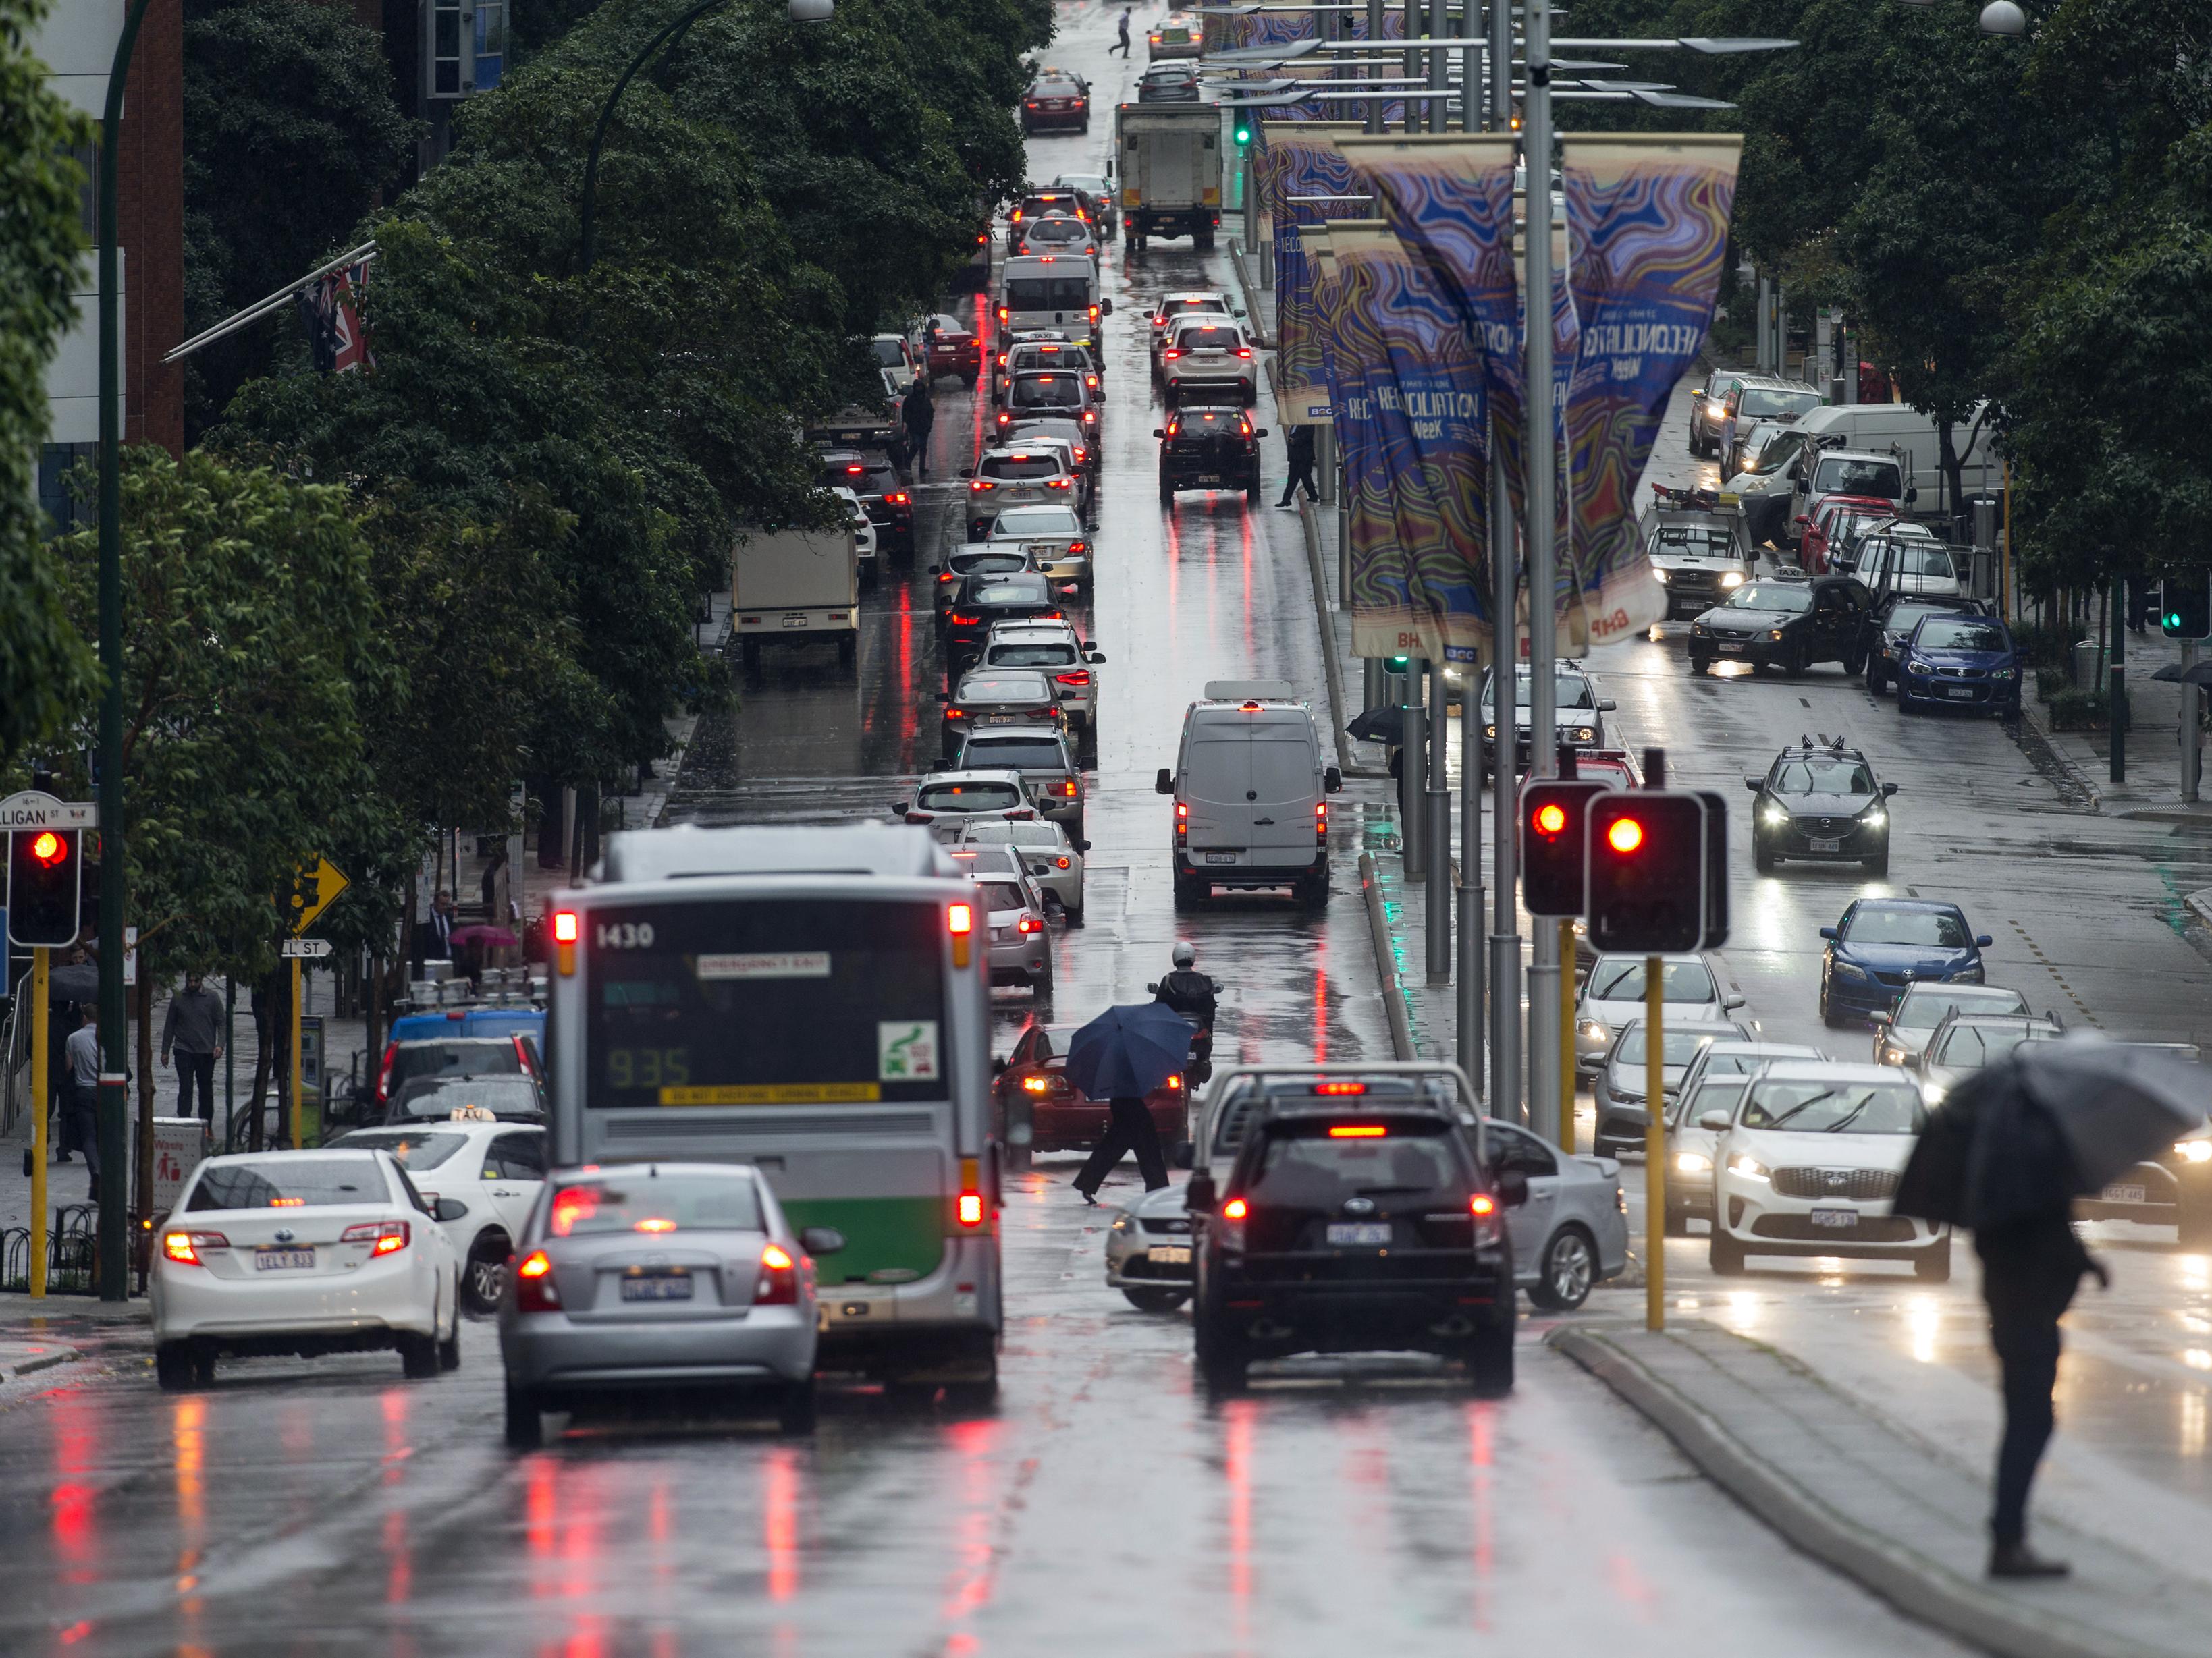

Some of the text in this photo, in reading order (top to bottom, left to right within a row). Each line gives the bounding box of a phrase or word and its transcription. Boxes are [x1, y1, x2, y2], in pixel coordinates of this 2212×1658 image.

[1397, 632, 1423, 648] BH
[0, 810, 59, 825] LIGAN ST
[597, 922, 654, 949] 1430
[304, 943, 319, 954] ST
[609, 1047, 689, 1088] 935
[455, 1109, 483, 1120] TAXI
